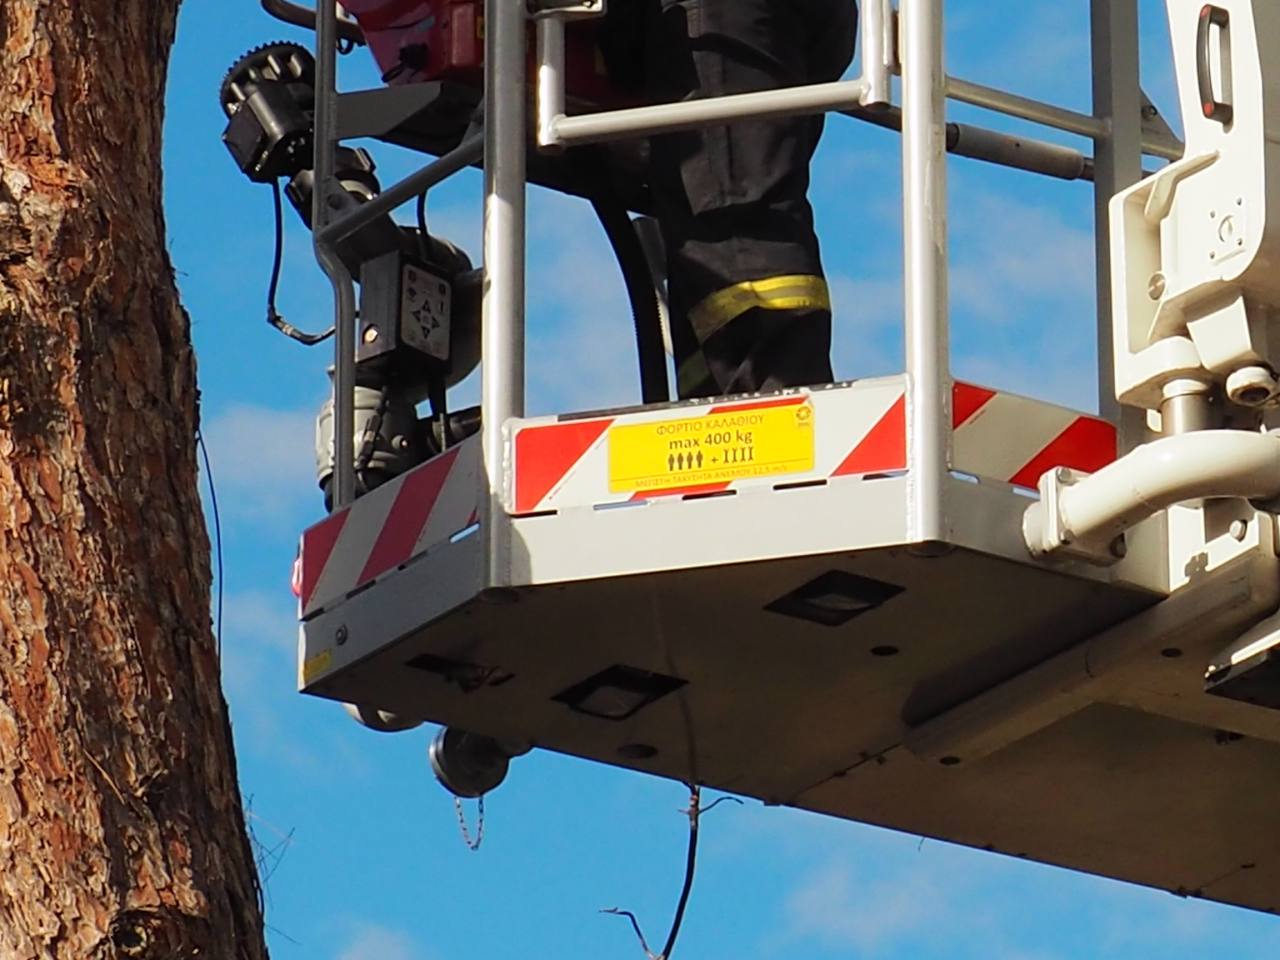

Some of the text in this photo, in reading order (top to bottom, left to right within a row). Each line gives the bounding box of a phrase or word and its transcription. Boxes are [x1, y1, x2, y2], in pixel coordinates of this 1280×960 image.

[656, 414, 765, 436] ΦΟΡΤΙΟ ΚΑΛΑΘΙΟΥ
[669, 429, 753, 450] max 400 kg
